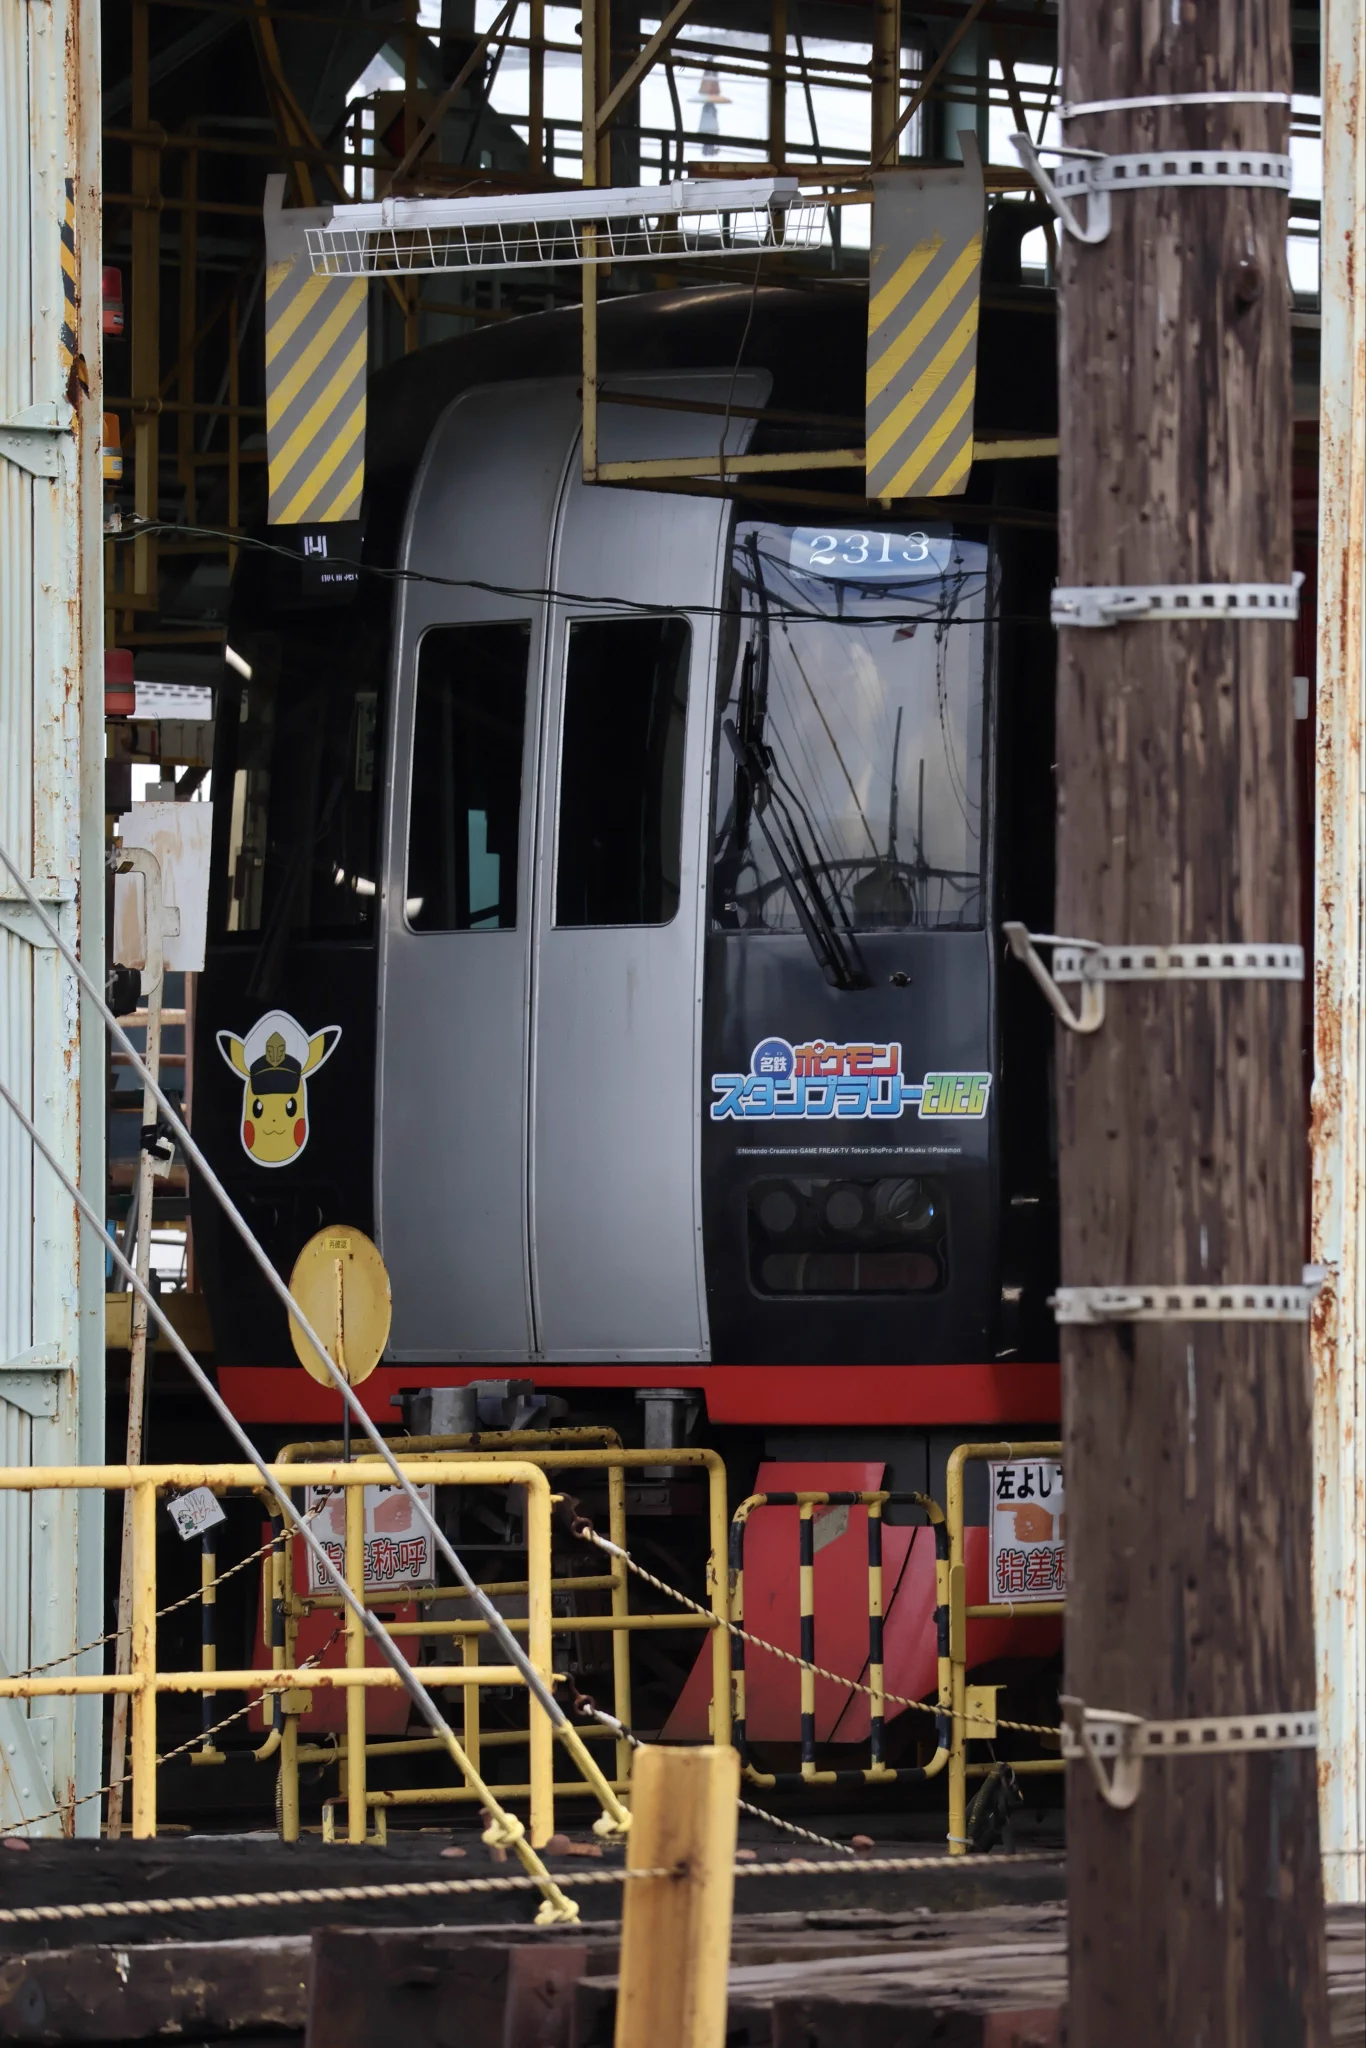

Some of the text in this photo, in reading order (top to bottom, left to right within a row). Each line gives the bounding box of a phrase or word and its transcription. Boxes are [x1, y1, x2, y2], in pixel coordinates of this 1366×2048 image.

[809, 531, 931, 565] 2313
[760, 1043, 899, 1077] 名鉄 ポケモン
